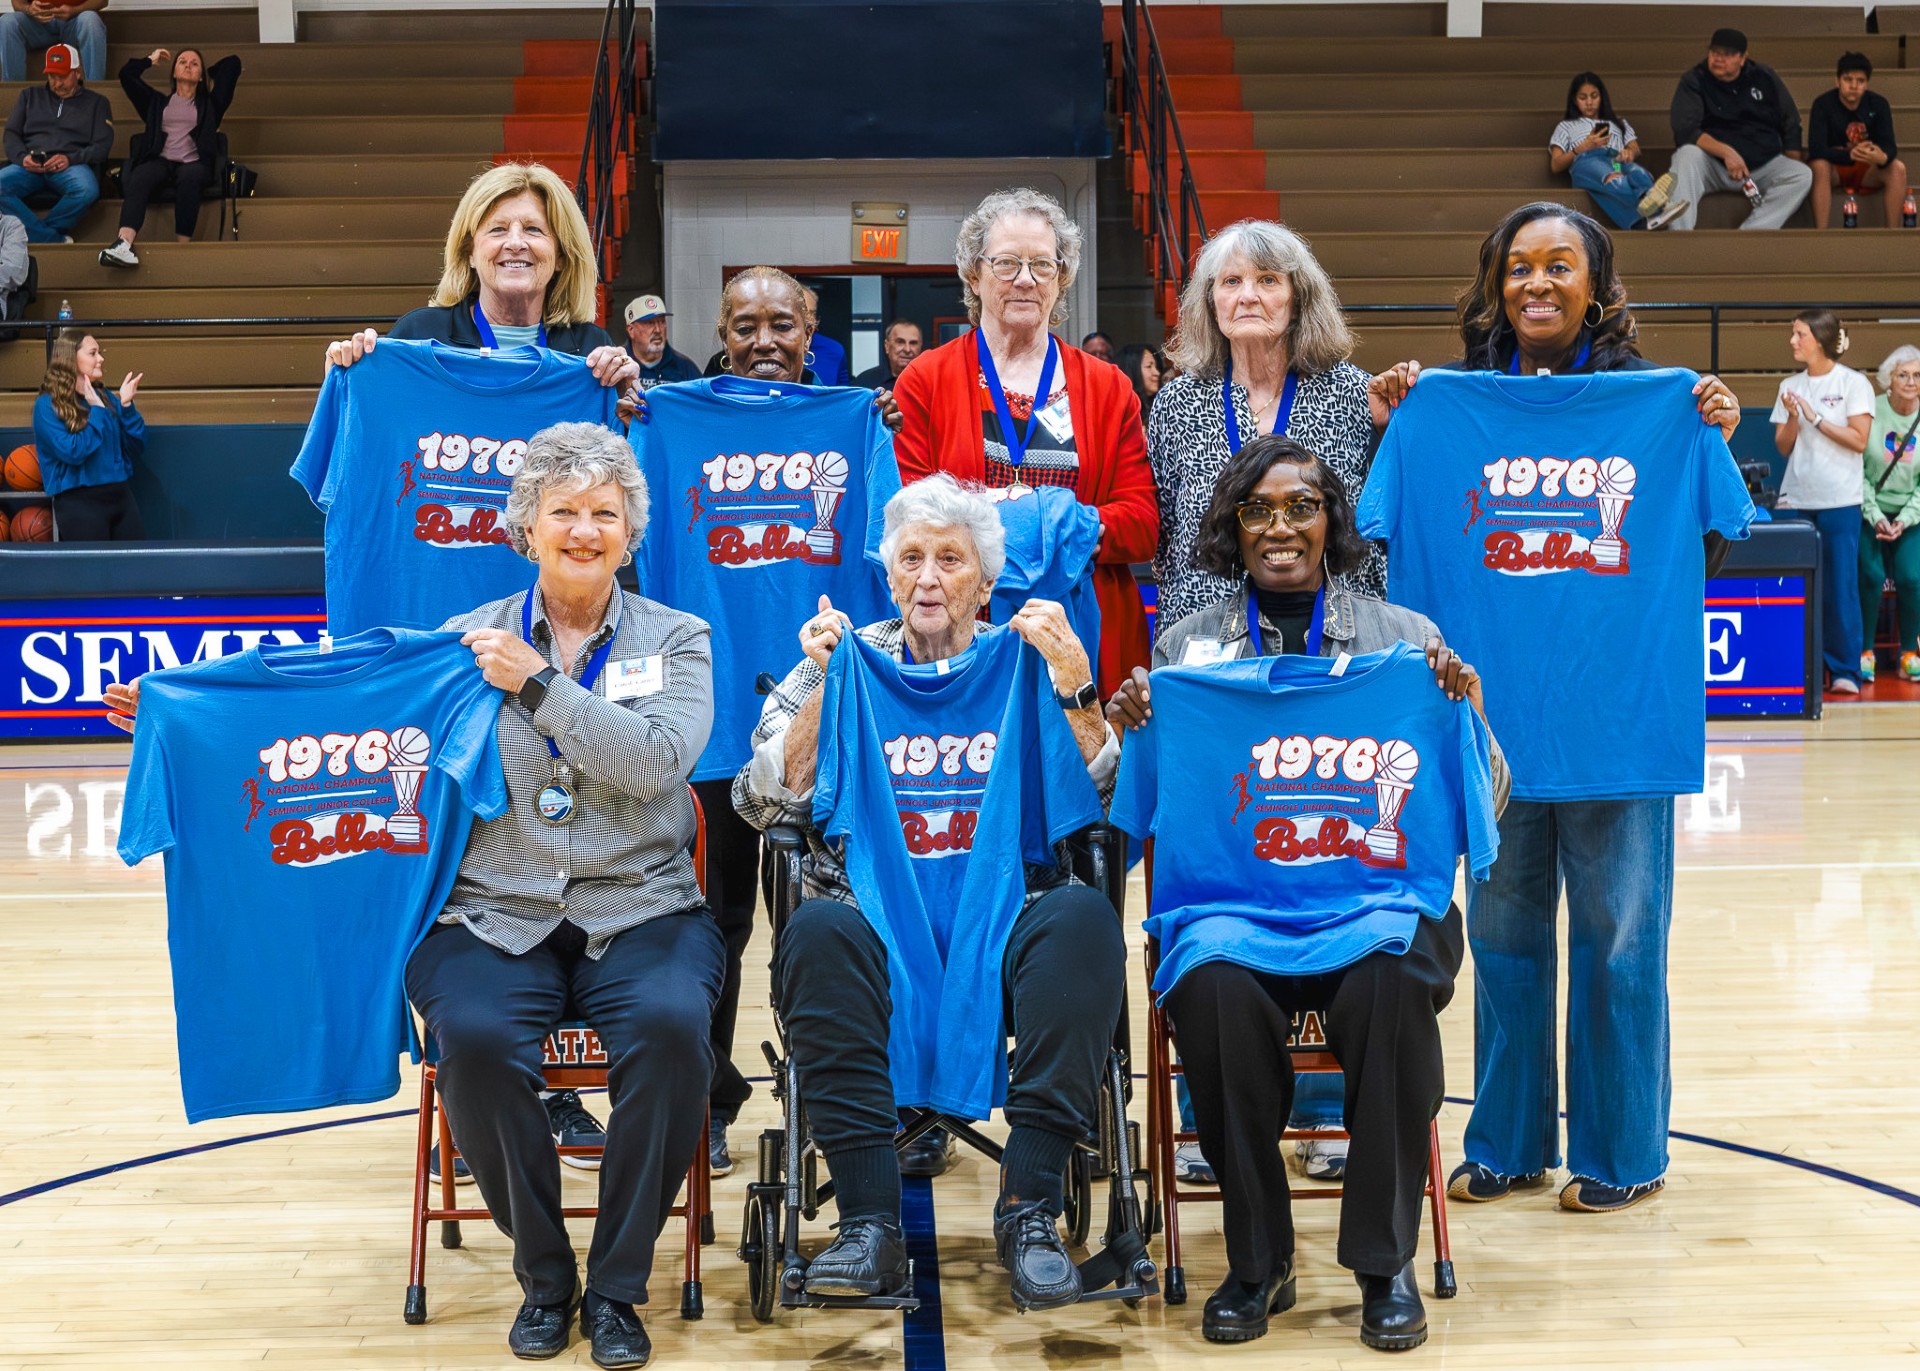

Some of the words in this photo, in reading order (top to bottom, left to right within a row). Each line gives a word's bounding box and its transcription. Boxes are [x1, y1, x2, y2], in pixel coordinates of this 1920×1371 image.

[862, 229, 900, 258] EXIT
[418, 430, 528, 478] 1976
[419, 472, 463, 483] NATIONAL
[702, 450, 814, 493] 1976
[1483, 456, 1599, 498] 1976
[417, 490, 455, 500] SEMINOLE
[456, 494, 485, 503] JUNIOR
[706, 494, 752, 503] NATIONAL
[755, 493, 814, 503] CHAMPIONS
[1486, 499, 1534, 508] NATIONAL
[1537, 499, 1597, 509] CHAMPIONS
[706, 513, 745, 522] SEMINOLE
[746, 512, 776, 520] JUNIOR
[1485, 518, 1525, 527] SEMINOLE
[1527, 519, 1558, 527] JUNIOR
[1560, 519, 1597, 528] COLLEGE
[707, 524, 812, 565] Belles
[1483, 530, 1597, 572] Belles
[259, 728, 390, 783] 1976
[884, 731, 998, 776] 1976
[1251, 735, 1380, 782] 1976
[267, 783, 321, 796] NATIONAL
[323, 775, 392, 789] CHAMPIONS
[1255, 782, 1307, 792] NATIONAL
[1311, 782, 1375, 795] CHAMPIONS
[267, 805, 313, 817] SEMINOLE
[315, 801, 349, 811] JUNIOR
[351, 796, 393, 807] COLLEGE
[1255, 803, 1298, 812] SEMINOLE
[1300, 803, 1334, 813] JUNIOR
[1336, 805, 1374, 815] COLLEGE
[270, 812, 395, 864] Belles
[1253, 816, 1372, 862] Belles
